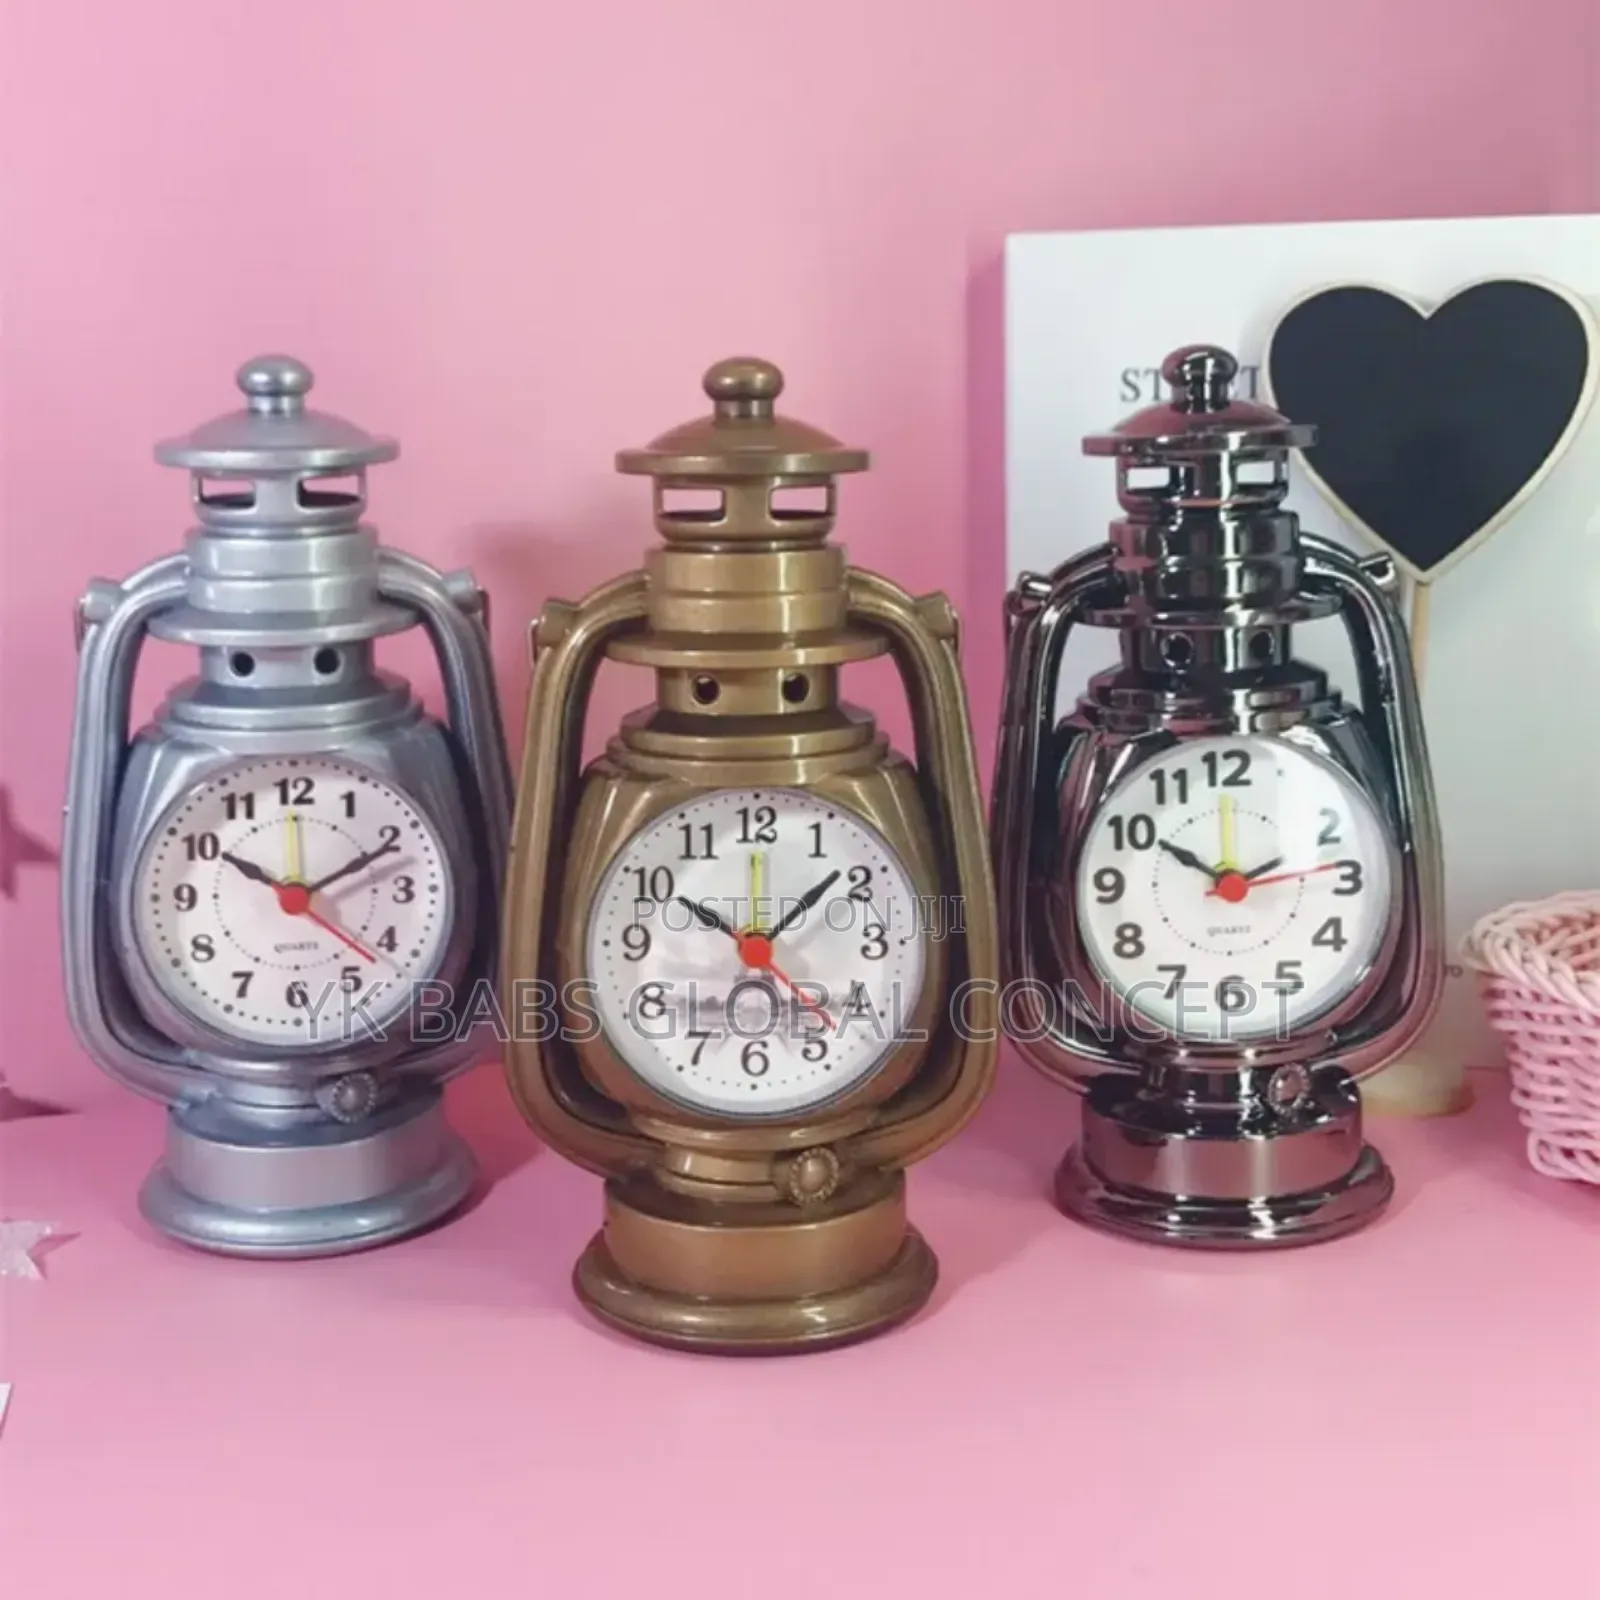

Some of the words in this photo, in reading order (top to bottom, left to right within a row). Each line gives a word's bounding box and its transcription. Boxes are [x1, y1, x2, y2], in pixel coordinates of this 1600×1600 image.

[1120, 366, 1261, 402] STT
[1201, 749, 1252, 787] 12
[273, 777, 315, 806] 12
[1149, 768, 1188, 805] 11
[221, 792, 256, 820] 11
[340, 791, 356, 819] 1
[378, 825, 402, 852] 2
[678, 822, 719, 860] 11
[735, 805, 777, 844] 12
[808, 822, 828, 858] 1
[1107, 813, 1157, 852] 10
[1317, 808, 1341, 846] 2
[181, 832, 220, 861] 10
[392, 876, 416, 904] 3
[632, 865, 675, 903] 10
[847, 865, 874, 903] 2
[1093, 867, 1126, 904] 9
[1332, 860, 1363, 896] 3
[173, 883, 198, 912] 9
[190, 934, 216, 962] 8
[376, 926, 398, 952] 4
[621, 923, 652, 961] 9
[860, 923, 889, 960] 3
[1113, 922, 1145, 959] 8
[1311, 917, 1348, 953] 4
[231, 970, 255, 999] 7
[285, 980, 310, 1009] 6
[339, 966, 363, 994] 5
[1156, 963, 1187, 1000] 7
[1214, 974, 1246, 1012] 6
[1274, 960, 1303, 996] 5
[638, 982, 668, 1019] 8
[842, 979, 872, 1018] 4
[685, 1031, 712, 1066] 7
[741, 1039, 769, 1077] 6
[801, 1026, 829, 1062] 5
